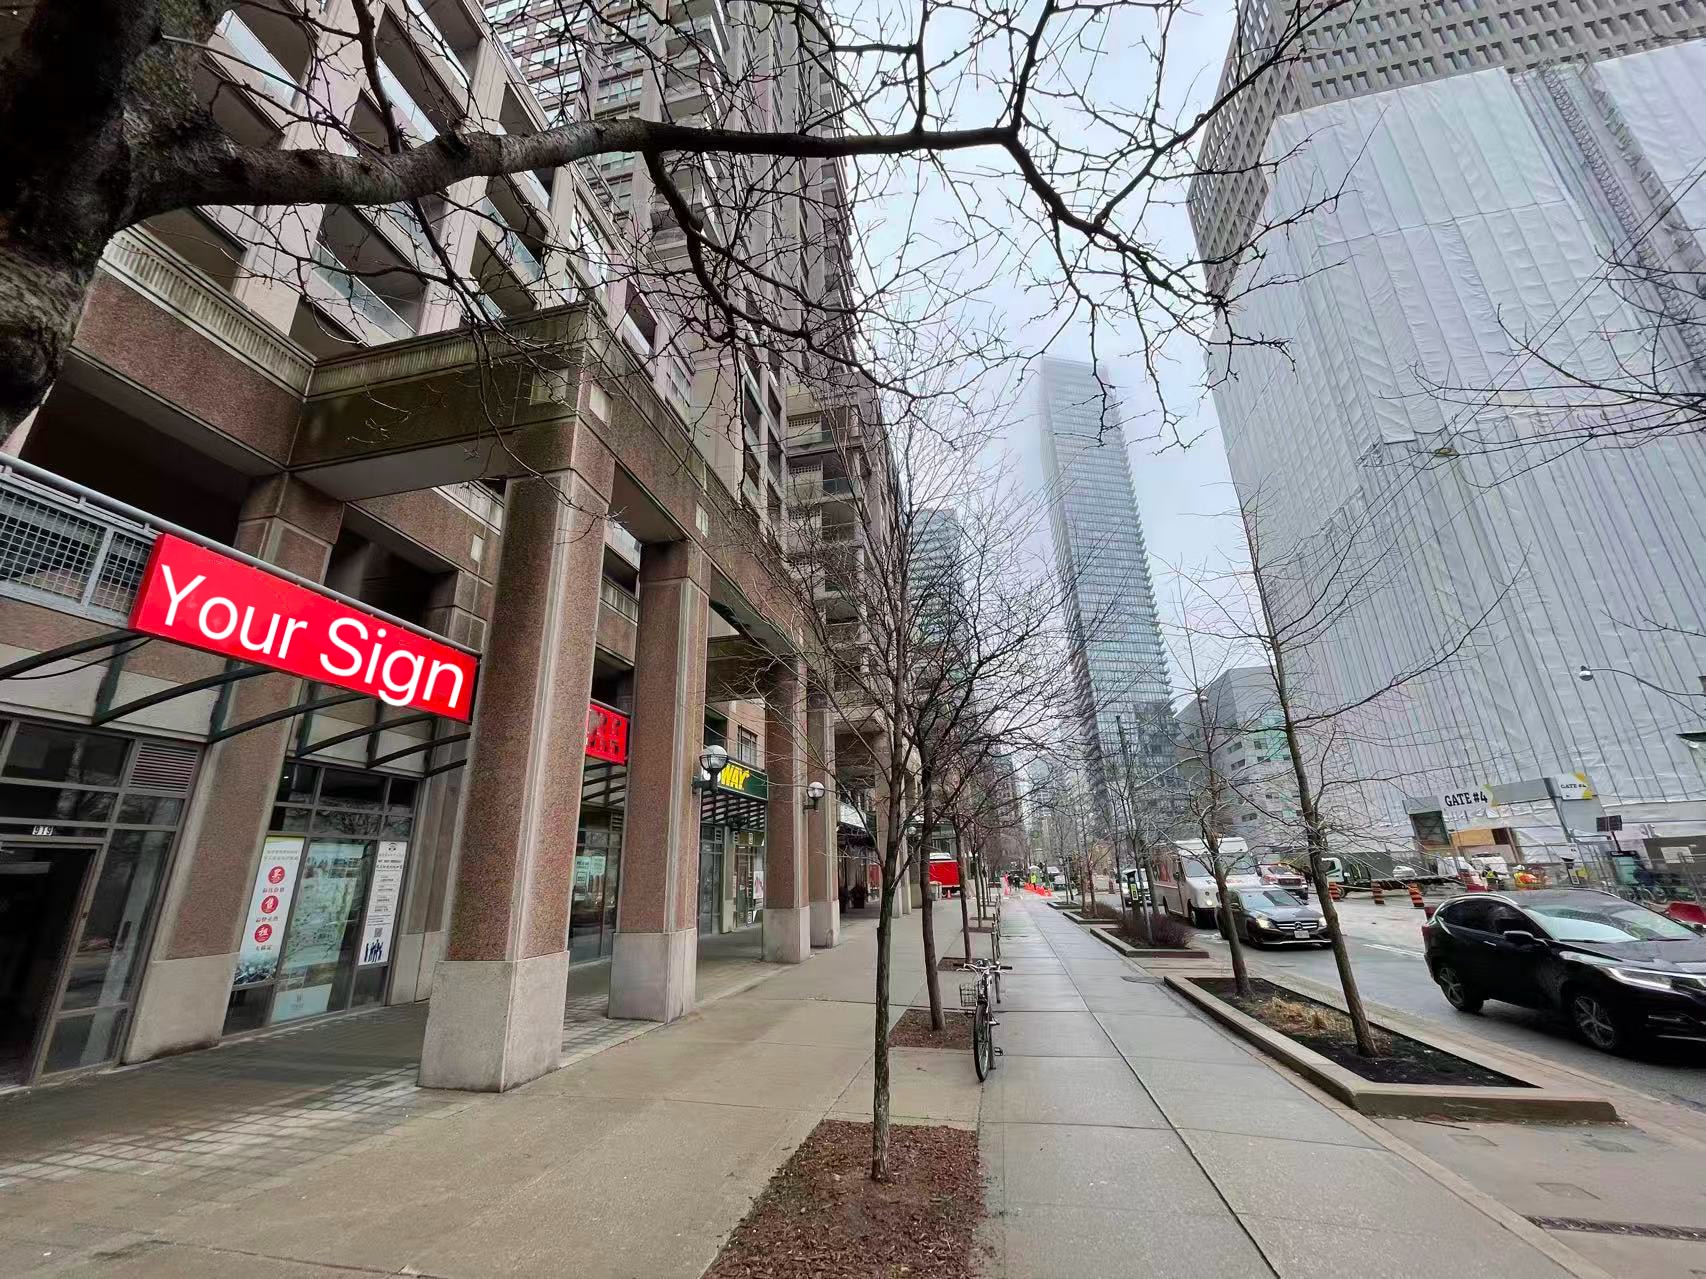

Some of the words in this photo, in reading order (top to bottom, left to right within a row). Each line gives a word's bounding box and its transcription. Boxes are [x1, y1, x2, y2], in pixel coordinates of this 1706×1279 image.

[1444, 792, 1472, 807] GATE
[1473, 791, 1488, 804] #4
[33, 825, 53, 835] 919
